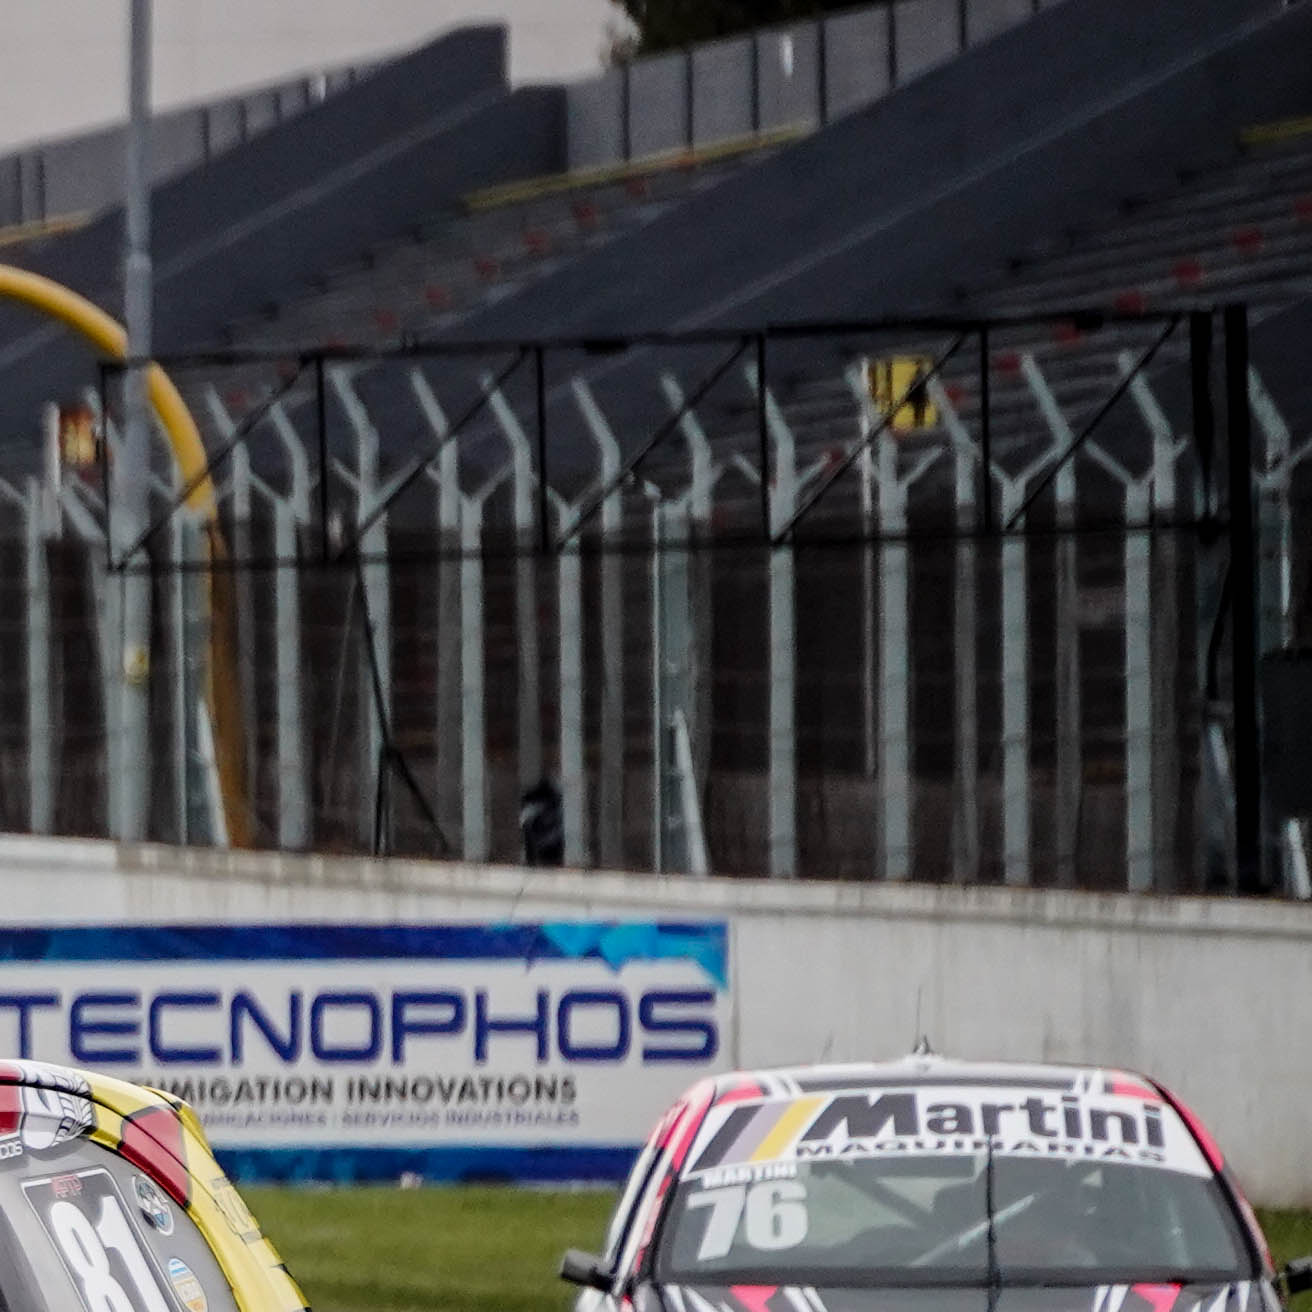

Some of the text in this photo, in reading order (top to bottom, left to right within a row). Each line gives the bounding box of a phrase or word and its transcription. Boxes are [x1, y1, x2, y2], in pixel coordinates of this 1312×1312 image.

[128, 1074, 576, 1105] MIGATION INNOVATIONS
[801, 1092, 1165, 1148] Martini
[796, 1138, 1167, 1163] MAQUINARIAS
[687, 1179, 808, 1261] 76
